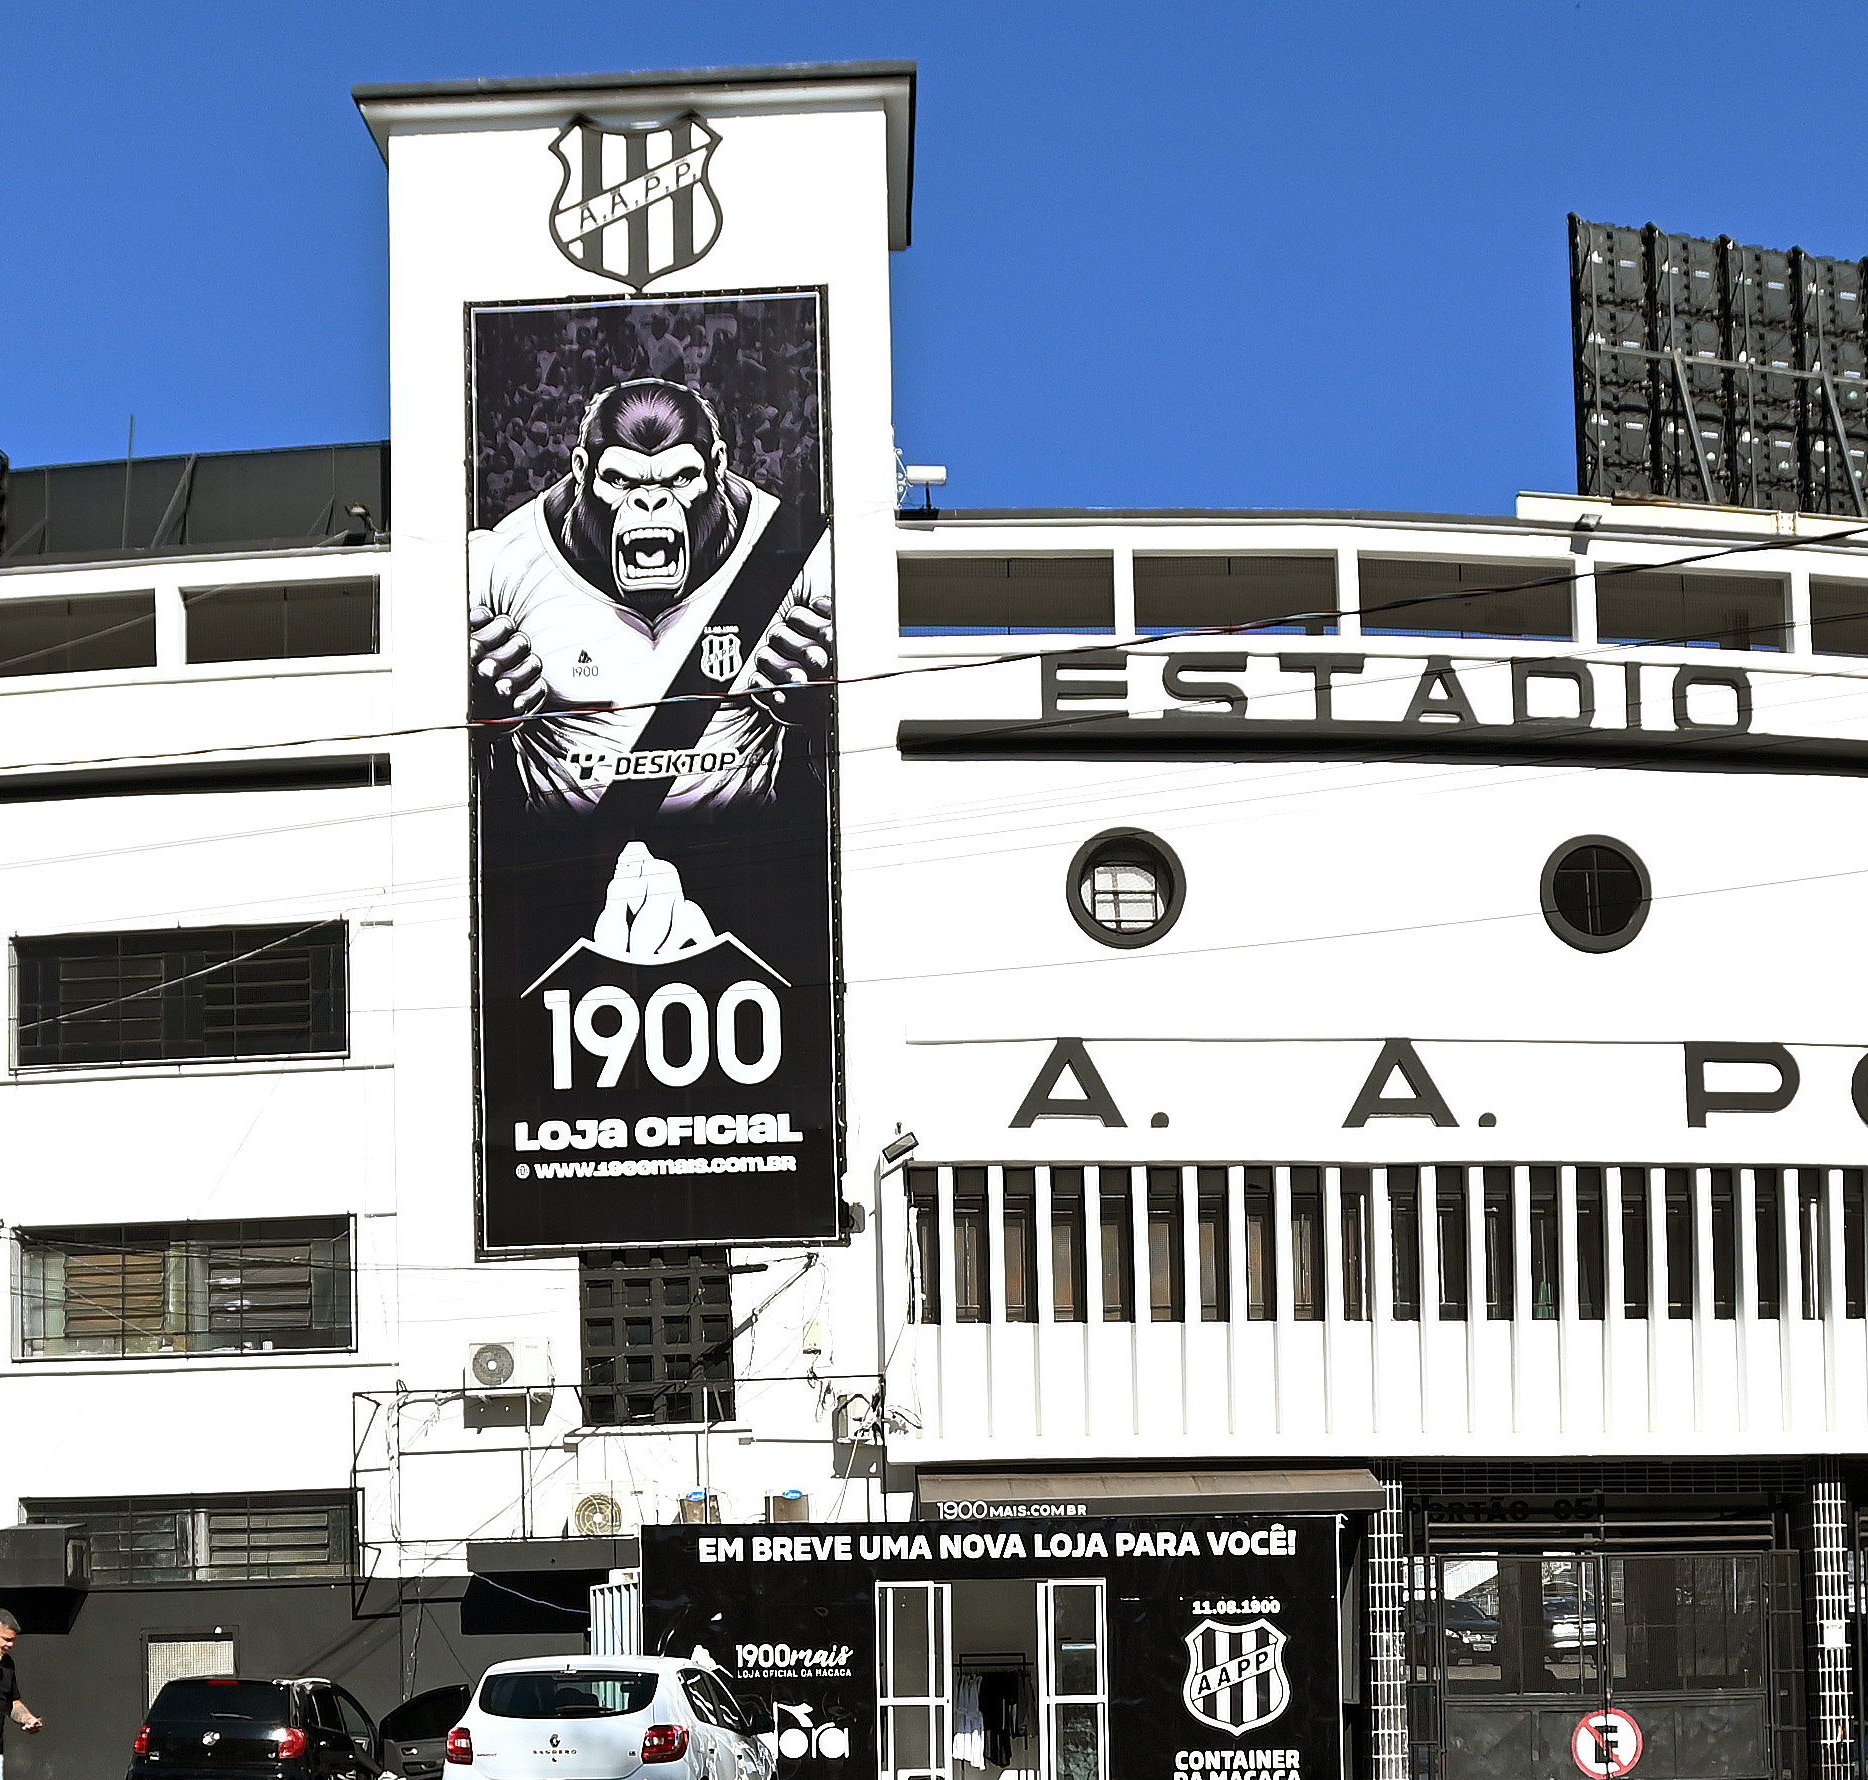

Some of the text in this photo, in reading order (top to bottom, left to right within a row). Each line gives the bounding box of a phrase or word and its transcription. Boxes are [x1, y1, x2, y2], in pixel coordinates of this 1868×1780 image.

[572, 666, 599, 678] 1900
[1040, 650, 1753, 734] ESTADIO
[543, 980, 782, 1090] 1900
[1008, 1037, 1170, 1129] A.
[1341, 1037, 1497, 1129] A.
[699, 1523, 1298, 1564] EM BREVE UMA NOVA LOJA PARA VOCÊ!
[737, 1668, 852, 1679] LOJA OFICIAL DA MACACA
[1175, 1750, 1301, 1771] CONTAINER
